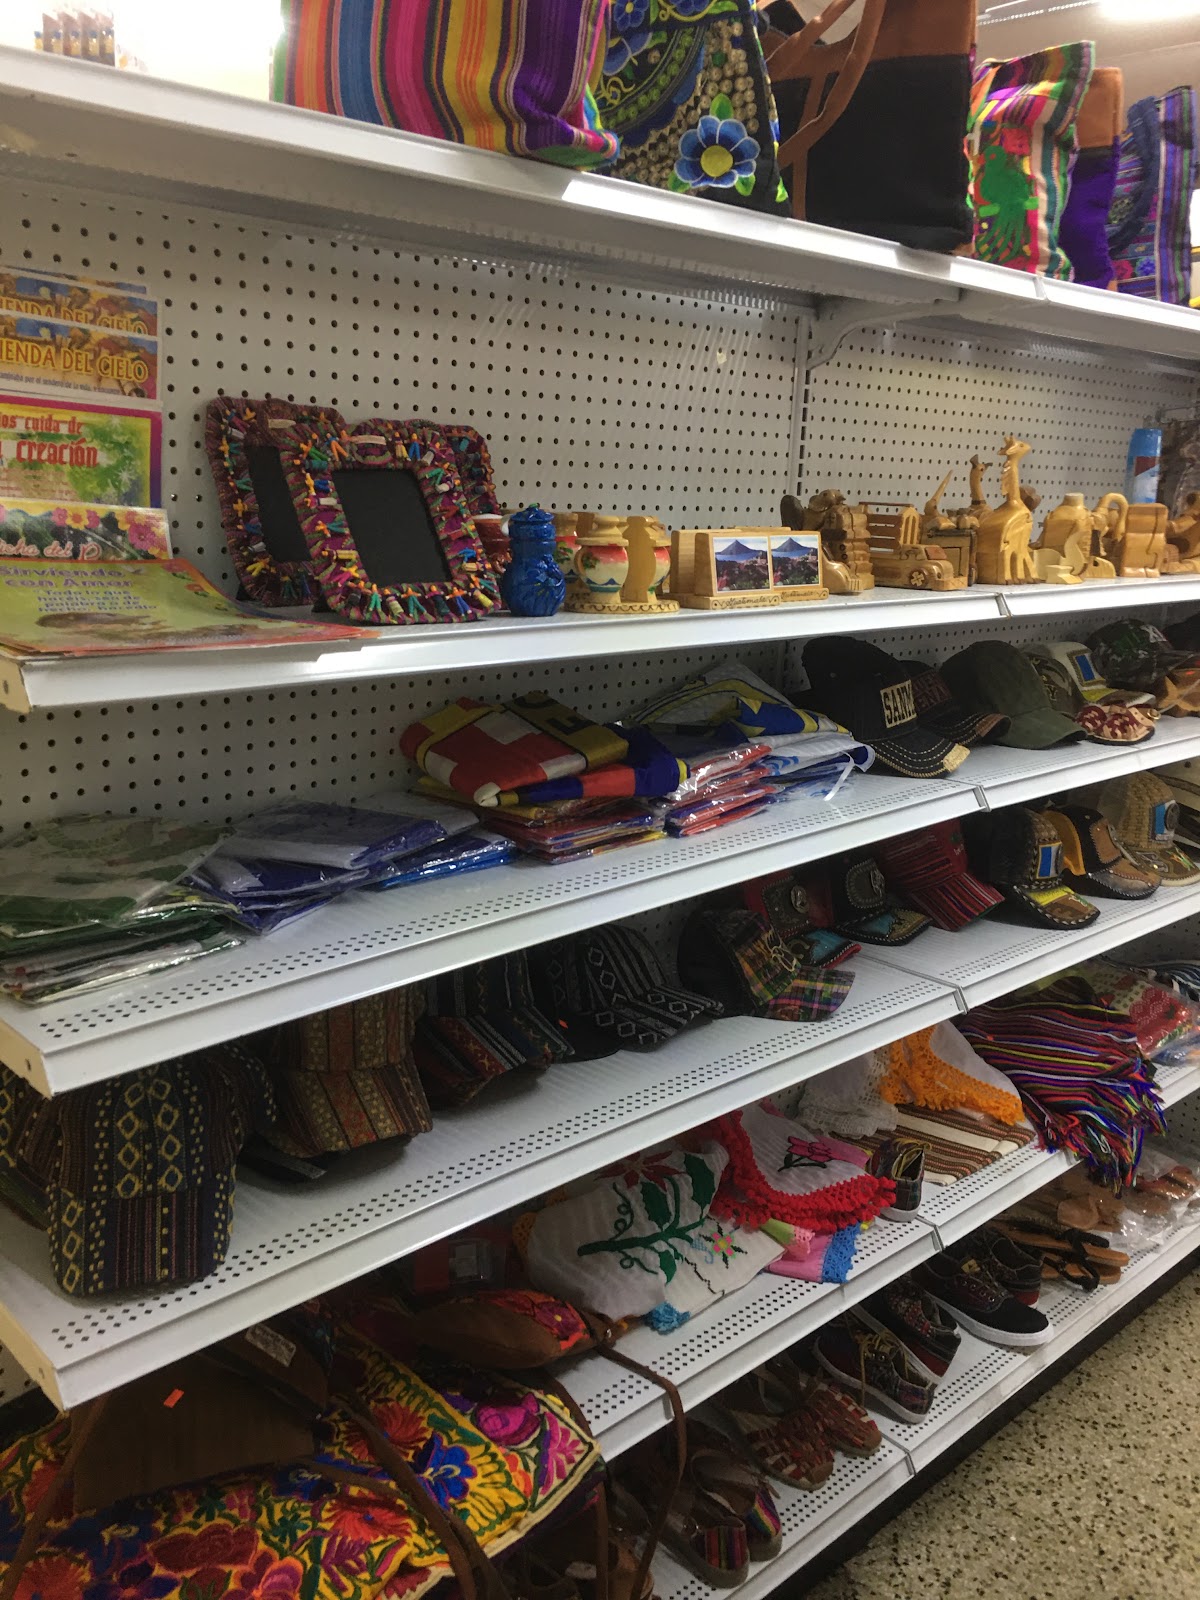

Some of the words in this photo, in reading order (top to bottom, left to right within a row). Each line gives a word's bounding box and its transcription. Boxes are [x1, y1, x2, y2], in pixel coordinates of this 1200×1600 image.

[62, 349, 93, 373] DEL
[98, 354, 149, 381] CIELO
[24, 413, 60, 434] cuida
[67, 415, 82, 435] de
[16, 436, 98, 468] creación
[5, 579, 55, 588] con
[63, 577, 132, 588] Amor
